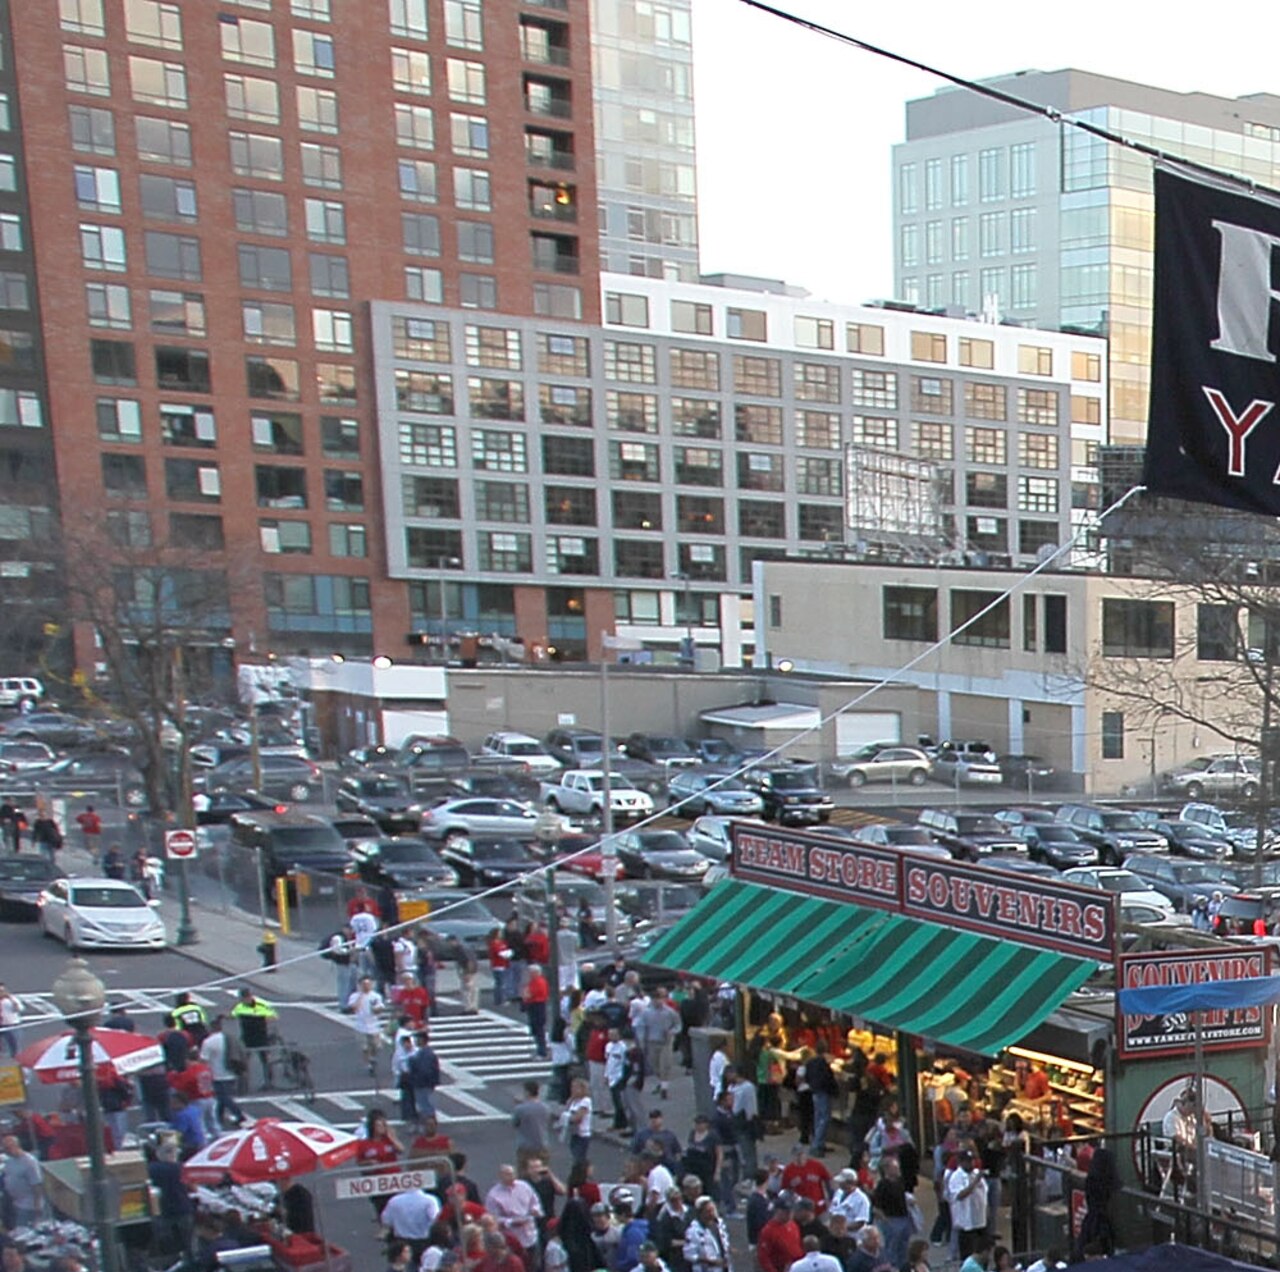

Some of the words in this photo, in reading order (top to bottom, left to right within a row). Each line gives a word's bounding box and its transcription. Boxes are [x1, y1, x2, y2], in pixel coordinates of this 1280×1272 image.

[737, 836, 806, 877] TEAM
[809, 848, 898, 893] STORE
[907, 867, 1107, 943] SOUVENIRS
[349, 1178, 374, 1194] NO
[377, 1171, 424, 1192] BAGS
